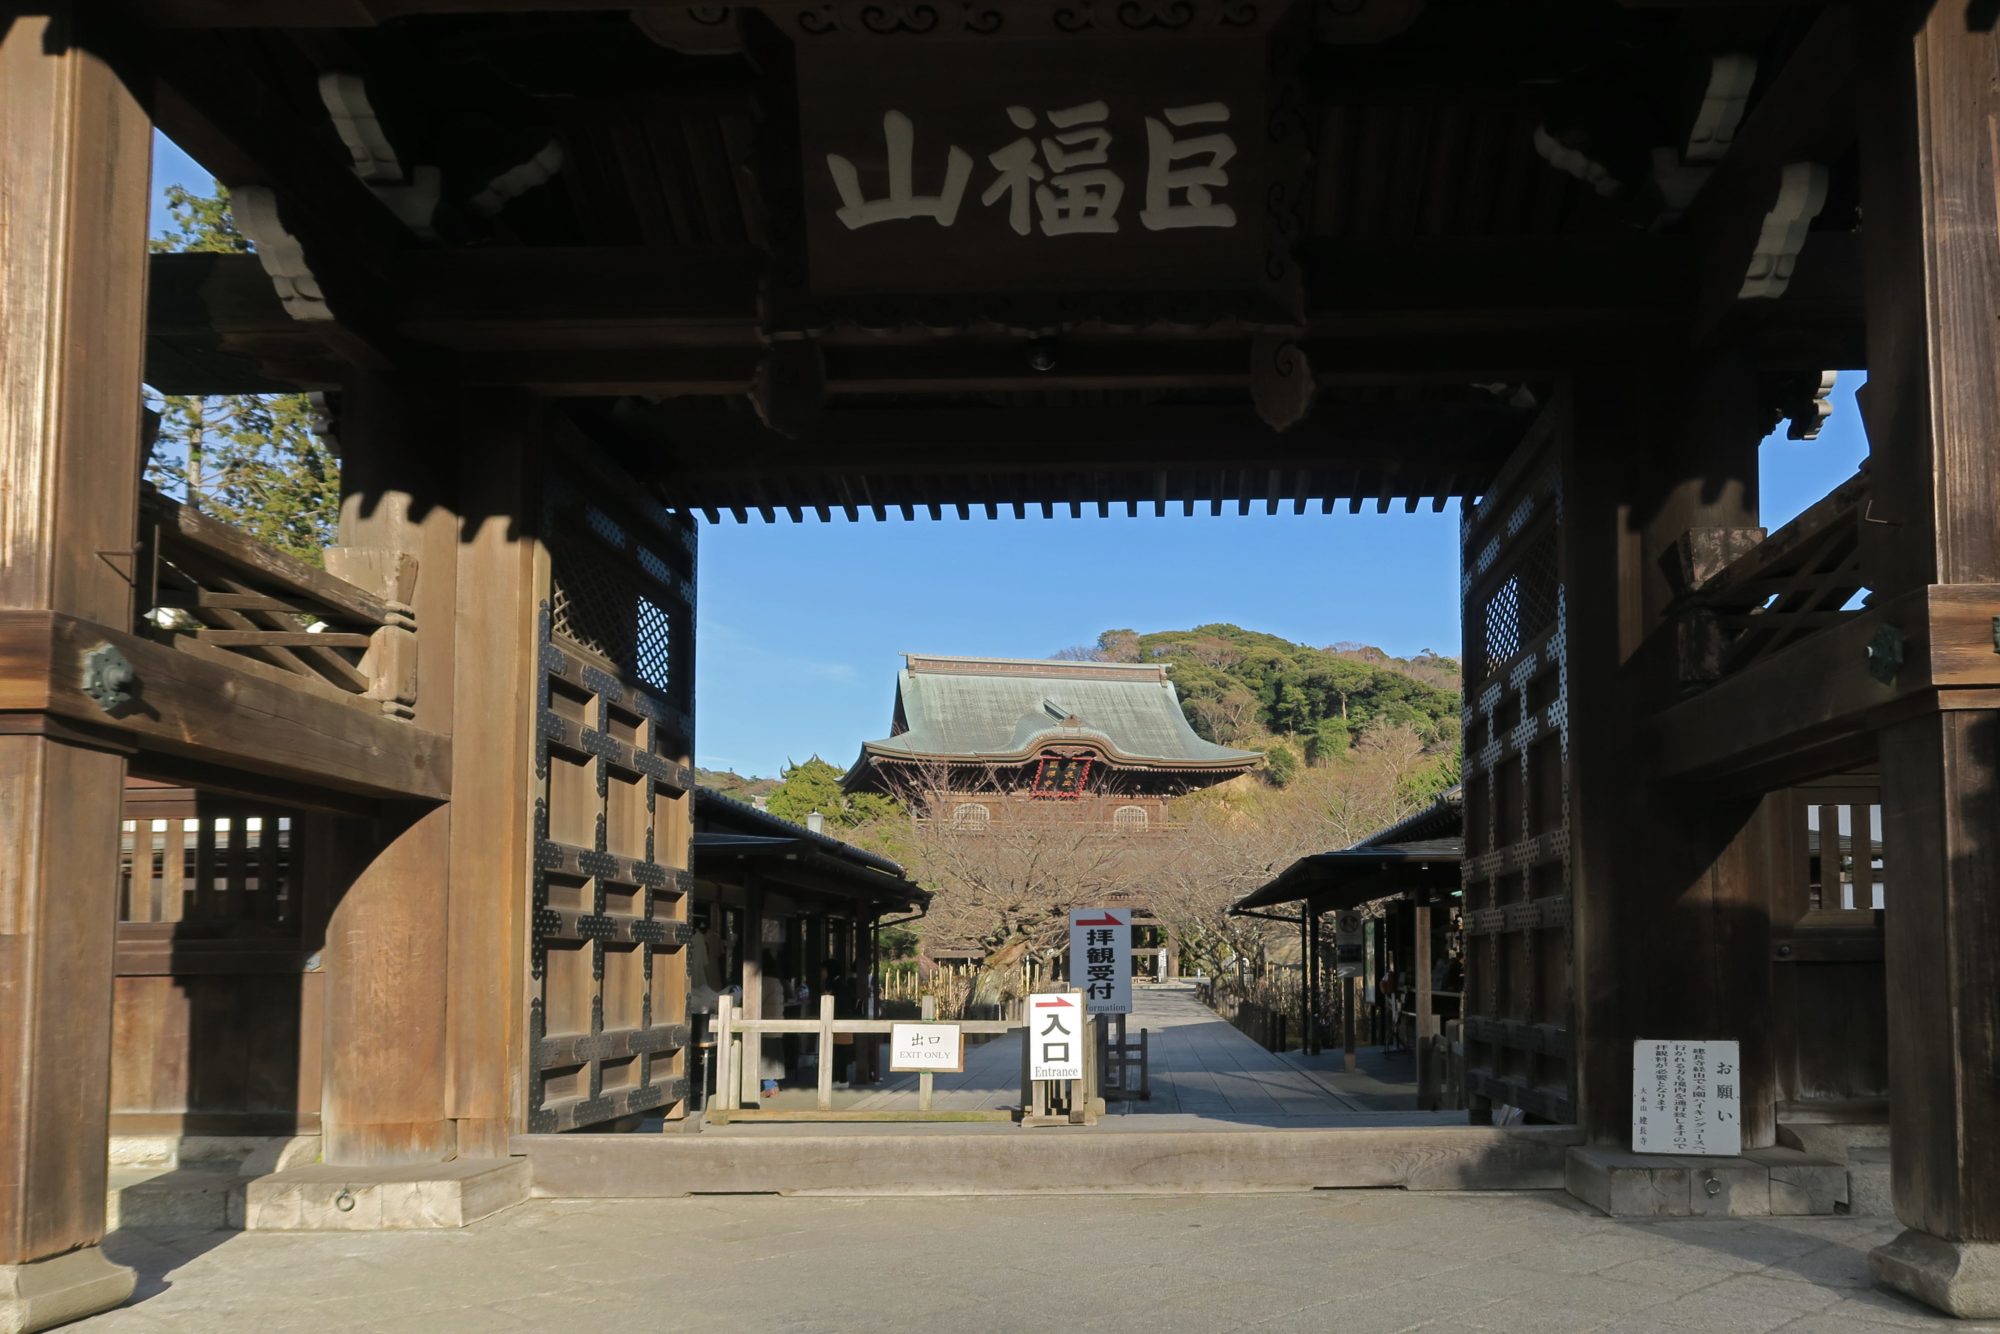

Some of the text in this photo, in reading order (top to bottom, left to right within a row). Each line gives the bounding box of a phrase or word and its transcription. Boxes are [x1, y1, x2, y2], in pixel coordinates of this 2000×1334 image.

[1086, 929, 1115, 1000] 拝観受付
[911, 1032, 941, 1046] 出口
[1041, 1013, 1071, 1063] 入口
[899, 1050, 951, 1059] EXIT ONLY
[1035, 1066, 1078, 1078] Entrance
[1716, 1061, 1733, 1122] お願い
[1639, 1116, 1648, 1146] 建長寺
